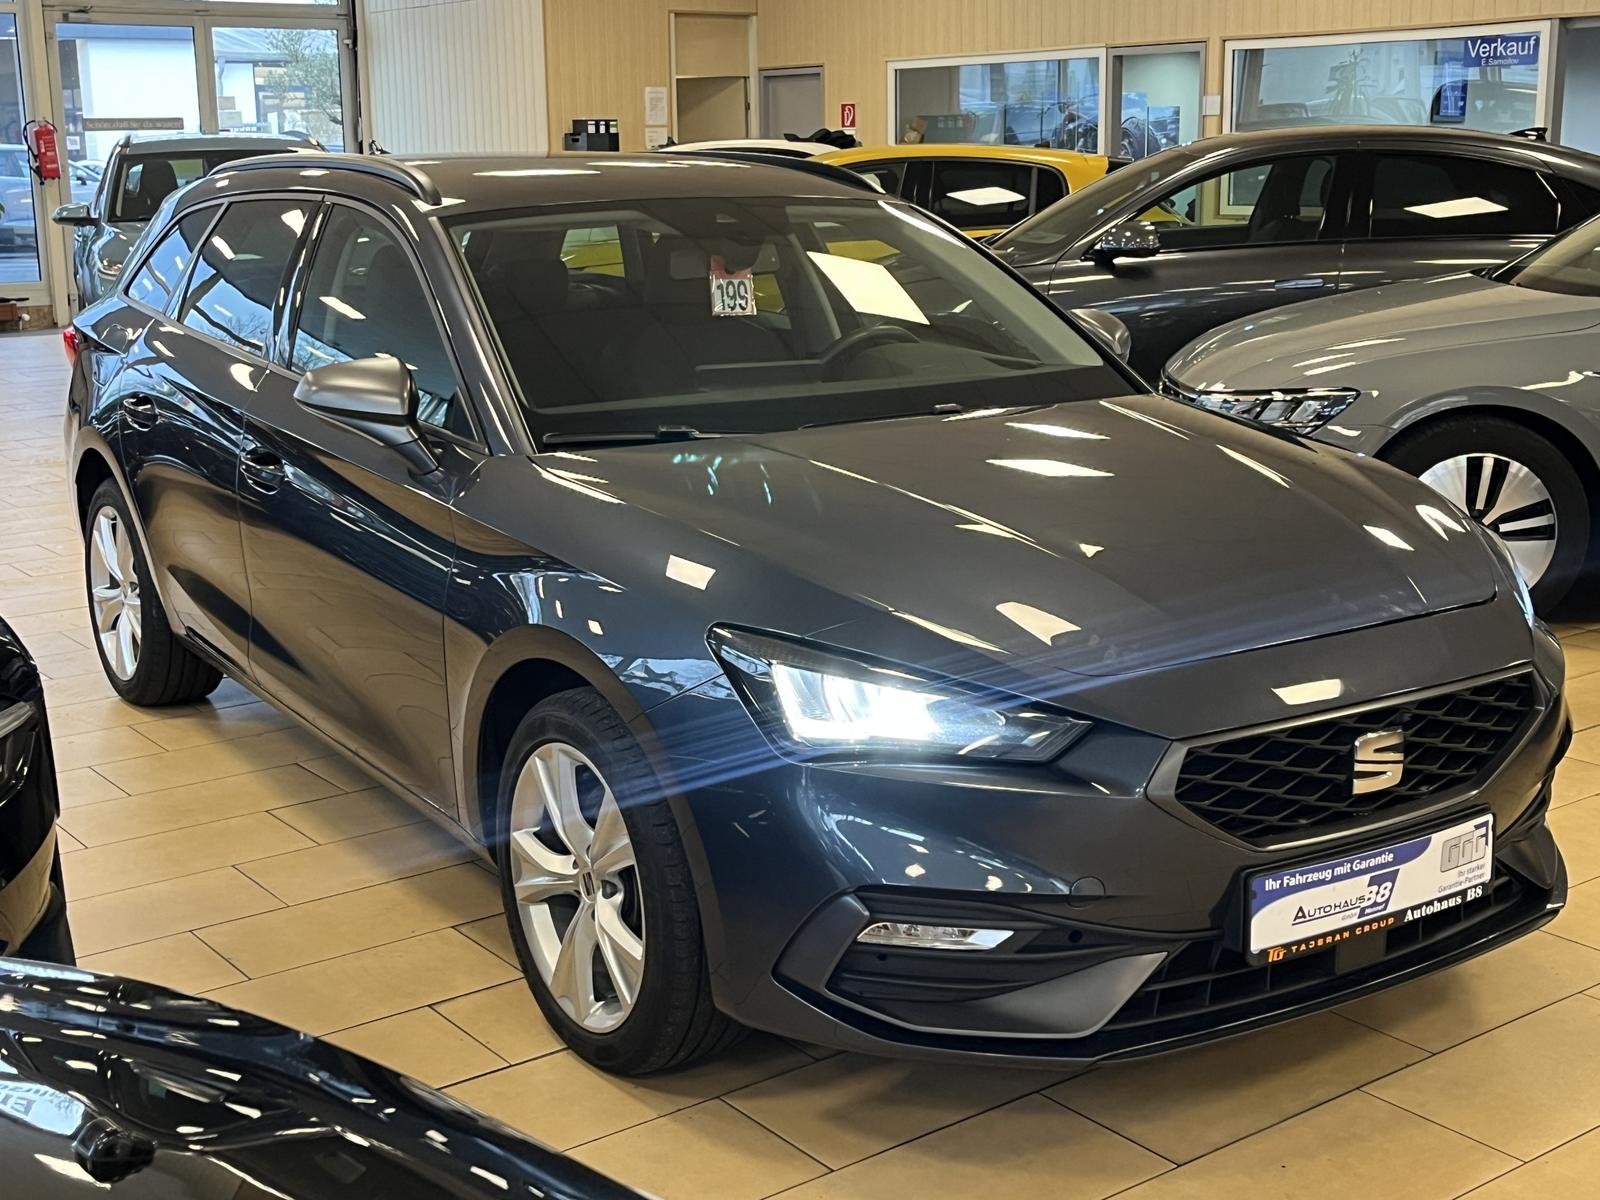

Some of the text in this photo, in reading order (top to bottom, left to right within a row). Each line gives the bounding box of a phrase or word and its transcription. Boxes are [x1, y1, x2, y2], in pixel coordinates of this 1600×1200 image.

[1467, 36, 1536, 58] Verkauf
[716, 280, 748, 311] 199
[1265, 852, 1394, 891] Ihr Fahrzeug mit Garantie
[1404, 885, 1483, 922] Autohaus B8
